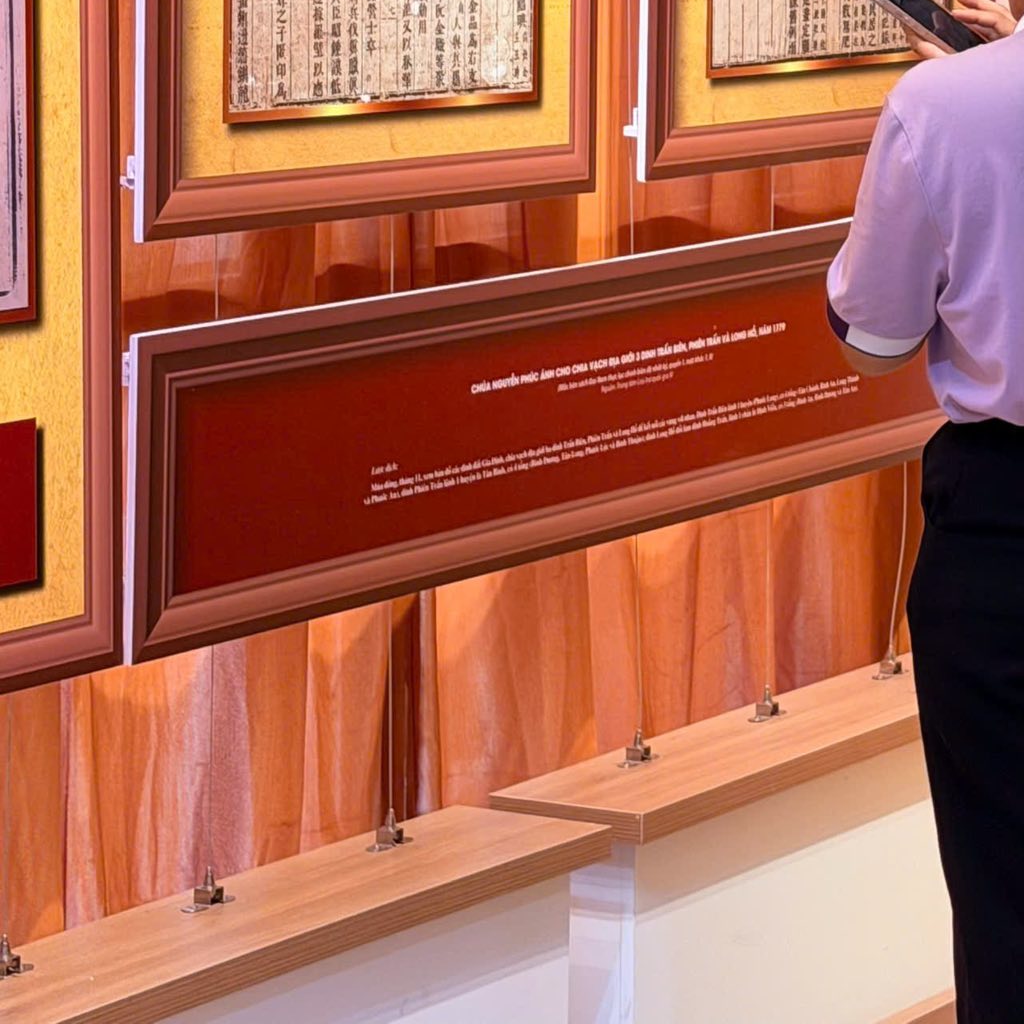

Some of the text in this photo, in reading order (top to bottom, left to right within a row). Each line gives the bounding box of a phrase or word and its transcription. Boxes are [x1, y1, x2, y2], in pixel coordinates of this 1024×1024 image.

[470, 379, 491, 394] CHÚA
[492, 372, 519, 390] NGUYỄN
[520, 370, 538, 384] PHÚC
[540, 366, 554, 380] ÁNH
[555, 364, 570, 377] CHO
[571, 361, 587, 374] CHIA
[589, 357, 607, 371] VẠCH
